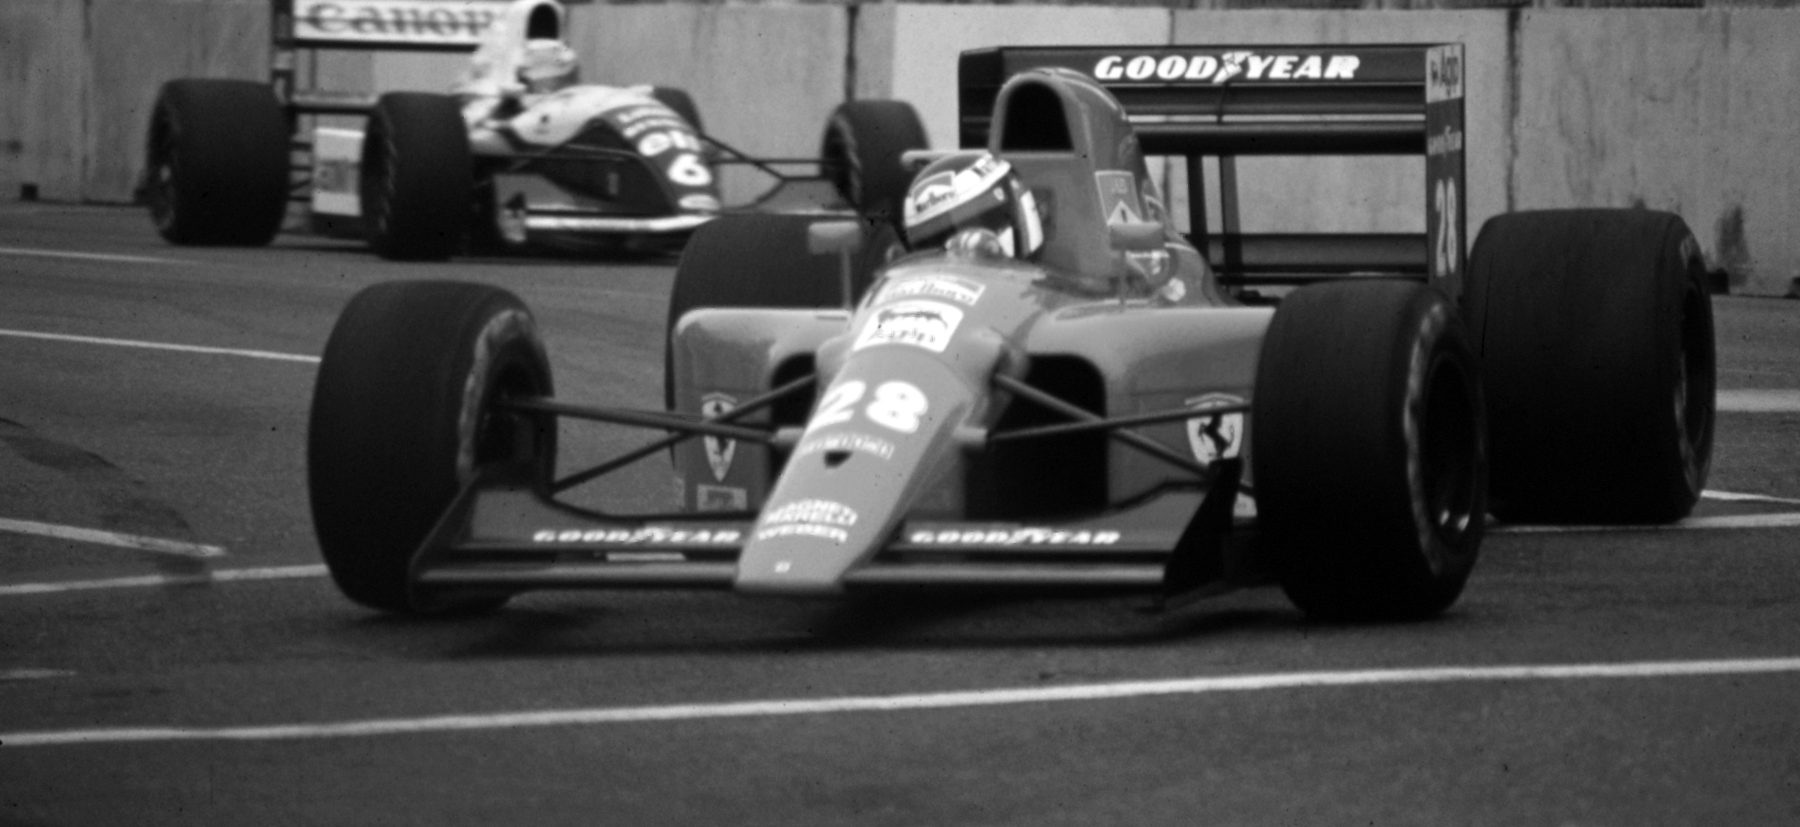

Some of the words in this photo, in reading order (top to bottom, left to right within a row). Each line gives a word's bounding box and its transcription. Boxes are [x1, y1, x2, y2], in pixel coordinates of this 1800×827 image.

[1094, 51, 1360, 83] GOODYEAR
[667, 154, 712, 186] 6
[1436, 177, 1457, 276] 28
[804, 379, 928, 435] 28
[533, 527, 740, 544] GOODYEAR
[910, 526, 1121, 545] GOODYEAR
